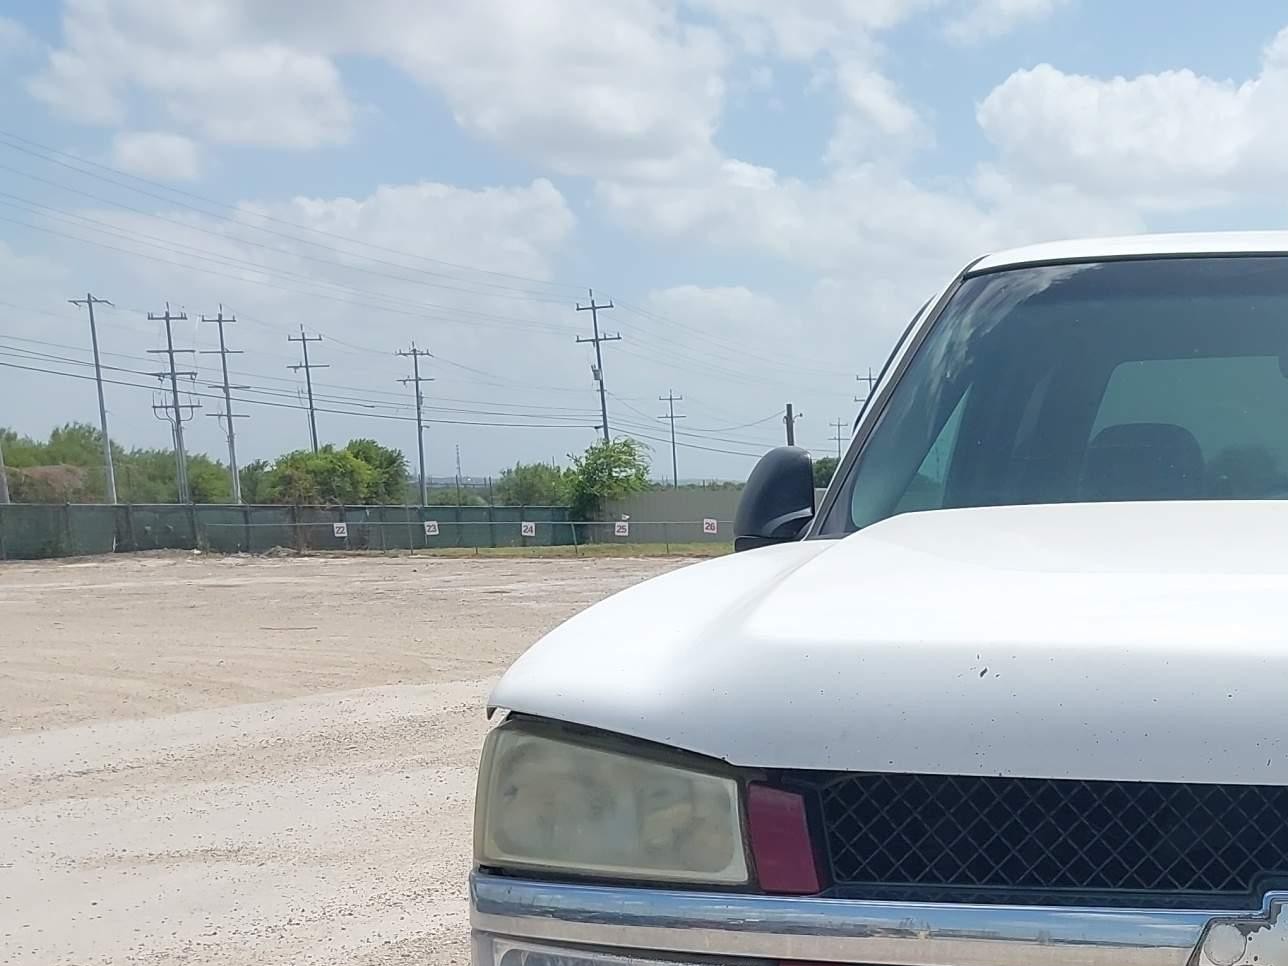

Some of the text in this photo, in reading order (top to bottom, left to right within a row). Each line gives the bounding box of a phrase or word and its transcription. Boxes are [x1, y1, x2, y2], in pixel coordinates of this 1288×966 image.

[335, 526, 346, 535] 22
[426, 524, 437, 533] 23
[522, 524, 534, 534] 24
[616, 524, 627, 534] 25
[704, 520, 716, 531] 26
